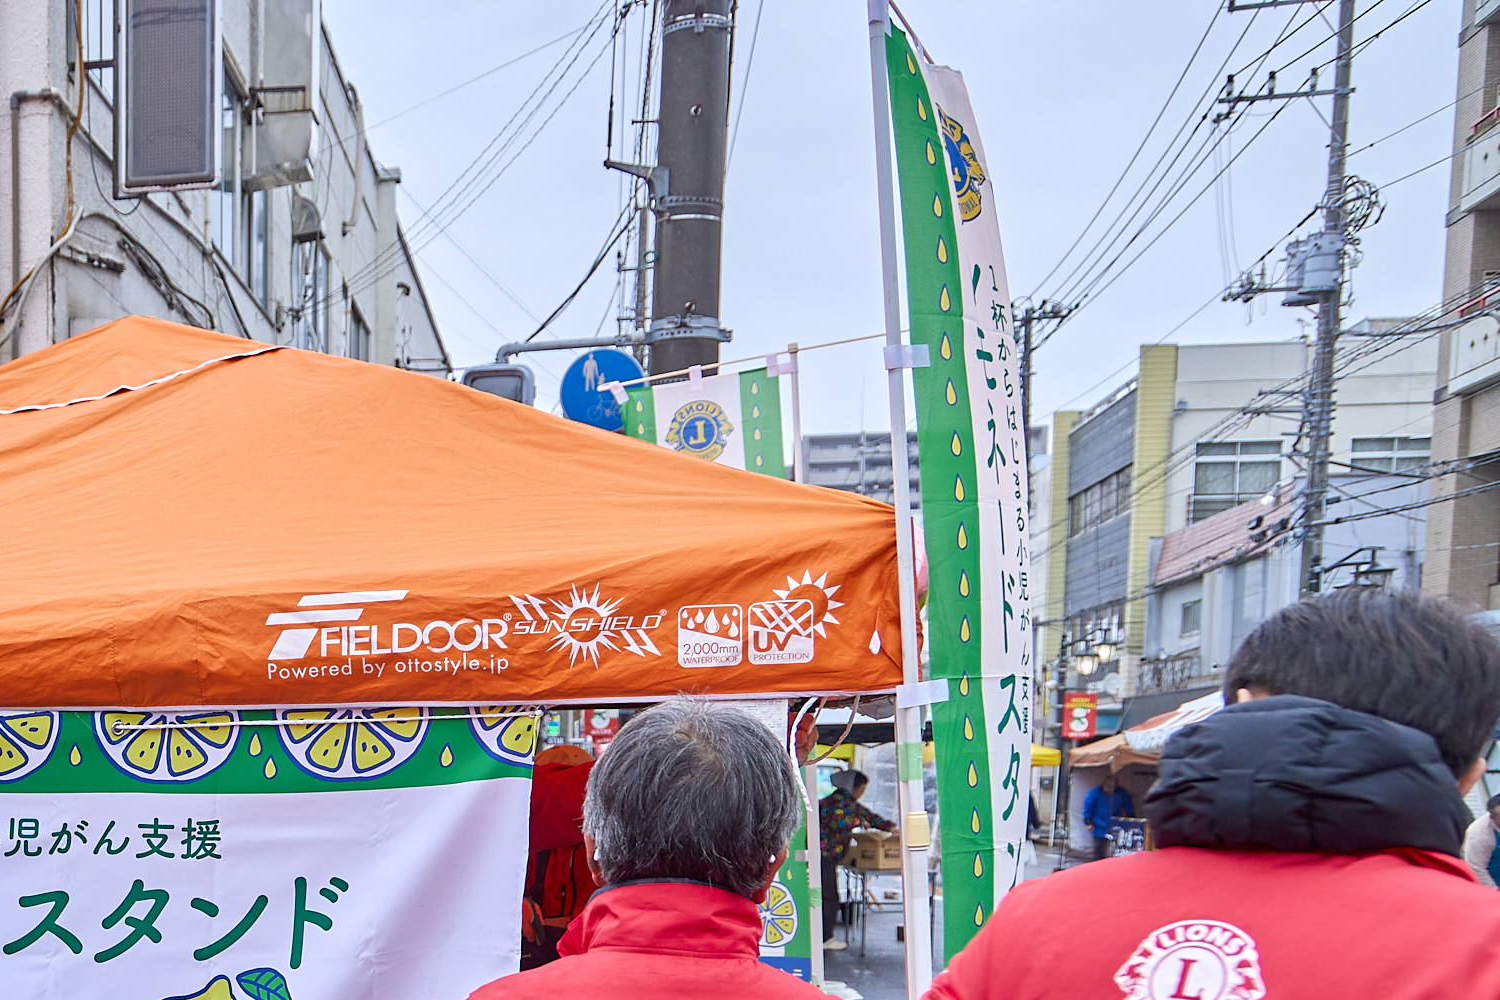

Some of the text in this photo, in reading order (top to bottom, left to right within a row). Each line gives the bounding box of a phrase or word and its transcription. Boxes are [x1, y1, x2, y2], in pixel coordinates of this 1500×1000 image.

[320, 618, 509, 657] FIELDOOR
[753, 630, 792, 653] UV
[682, 654, 740, 665] WATERPROOF
[683, 643, 739, 656] 2,000mm
[753, 652, 810, 662] PROTECTION
[267, 652, 509, 680] Powered by ottostyle.jp
[1158, 924, 1245, 956] LIONS
